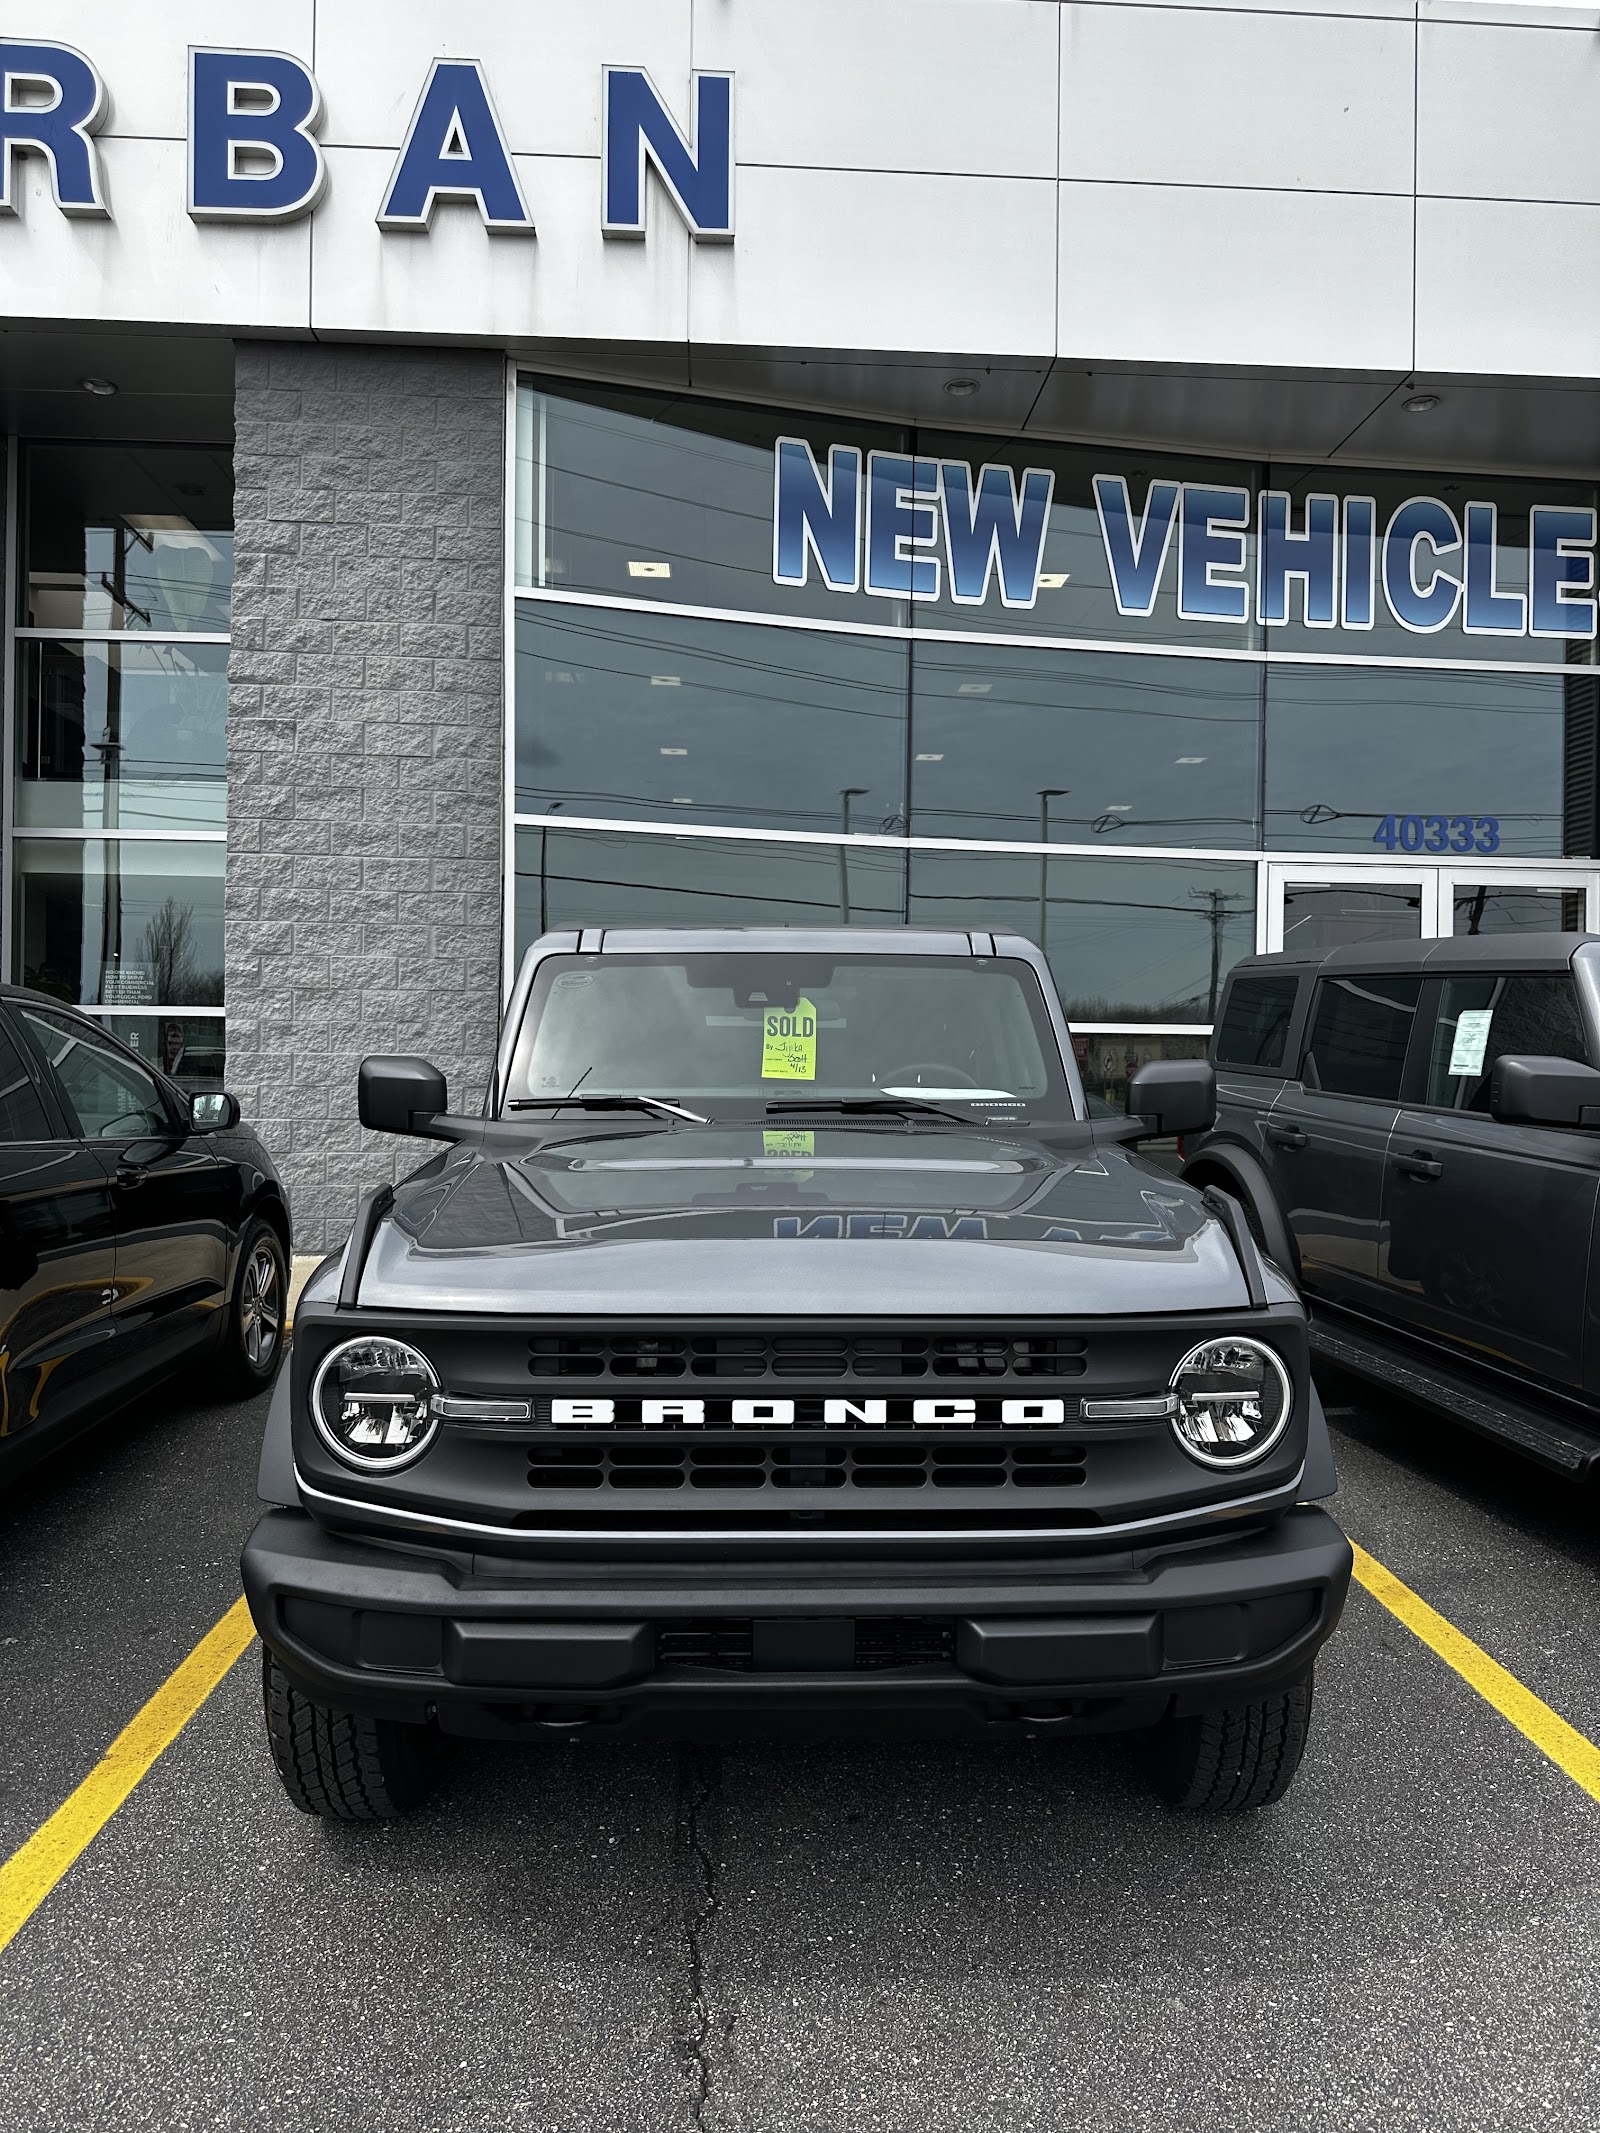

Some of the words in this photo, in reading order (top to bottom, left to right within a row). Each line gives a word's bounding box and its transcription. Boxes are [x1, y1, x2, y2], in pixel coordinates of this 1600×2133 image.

[0, 37, 736, 243] RBAN
[773, 436, 1056, 610] NEW
[1092, 473, 1600, 640] VEHICLE
[1373, 814, 1501, 853] 40333
[130, 1032, 140, 1053] ER
[767, 1015, 814, 1038] SOLD
[550, 1399, 1065, 1424] BRONCO
